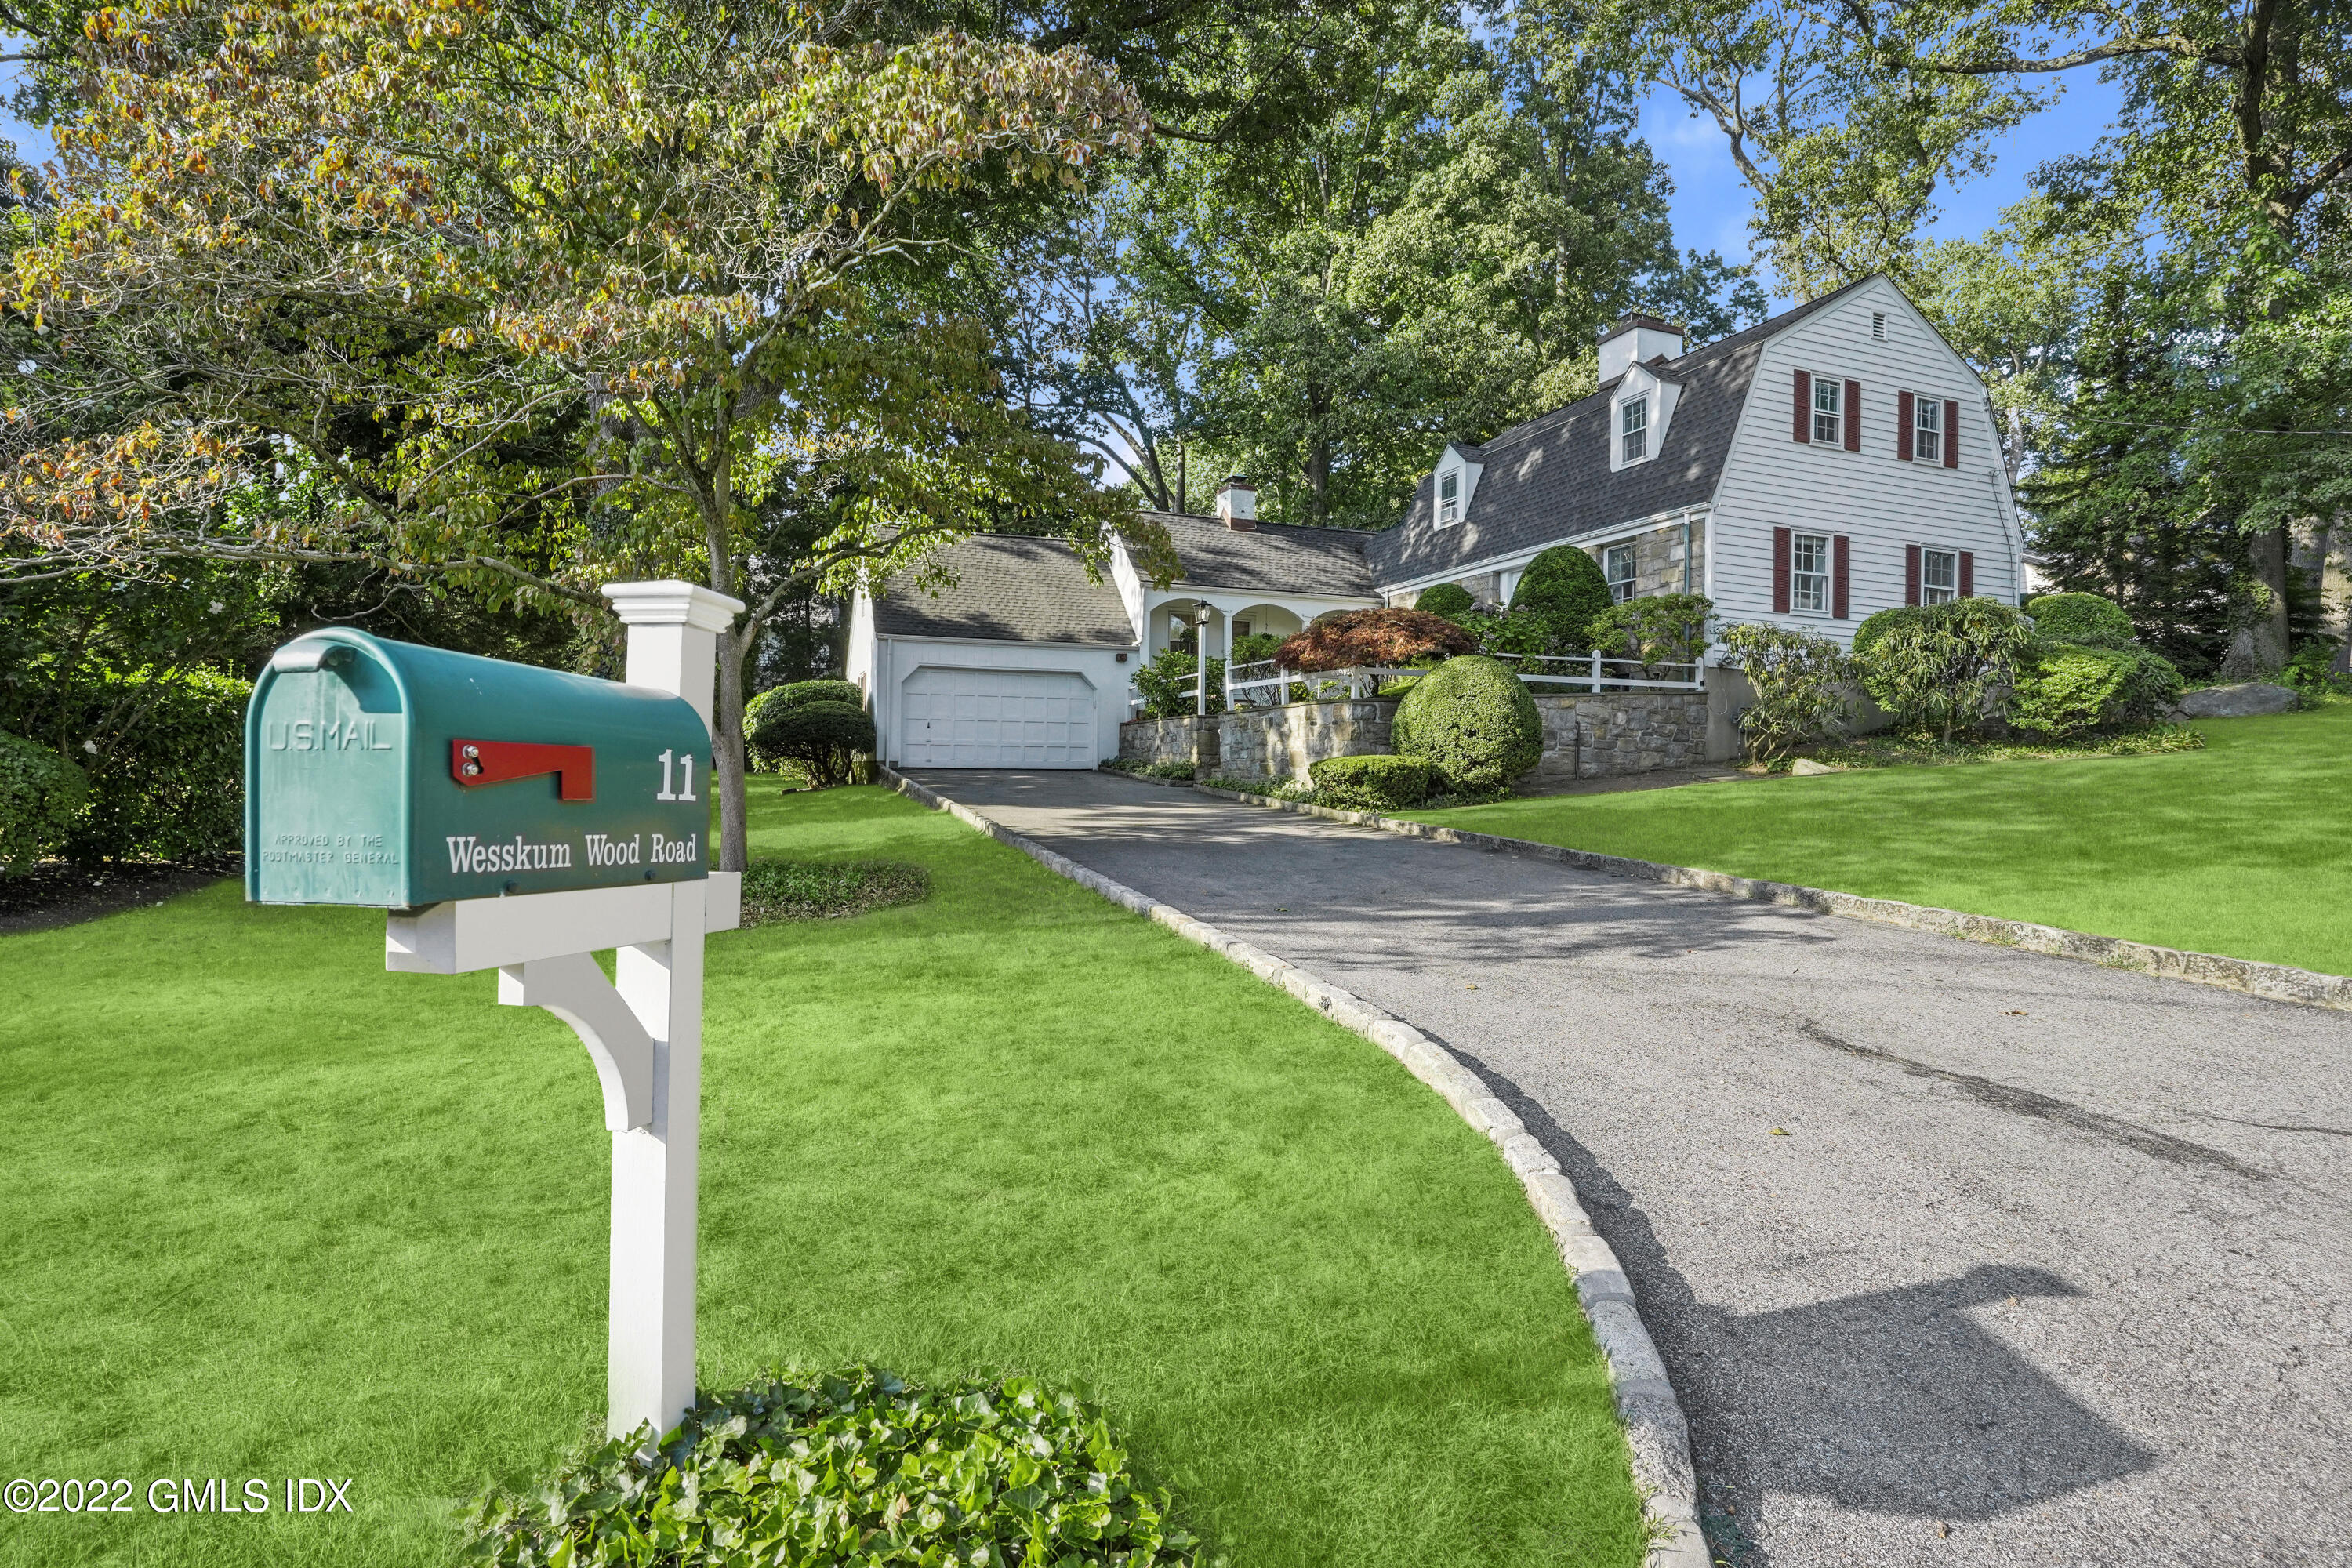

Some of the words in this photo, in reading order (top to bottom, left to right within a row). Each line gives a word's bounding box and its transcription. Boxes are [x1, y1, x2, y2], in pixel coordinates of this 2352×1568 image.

[657, 748, 696, 801] 11
[275, 833, 329, 847] APPROVED
[337, 834, 351, 847] BY
[361, 834, 383, 848] THE
[446, 835, 571, 873] Wesskum
[585, 833, 640, 866] Wood
[651, 833, 696, 863] Road
[263, 851, 334, 863] POSTMASTER
[344, 852, 400, 865] GENERAL
